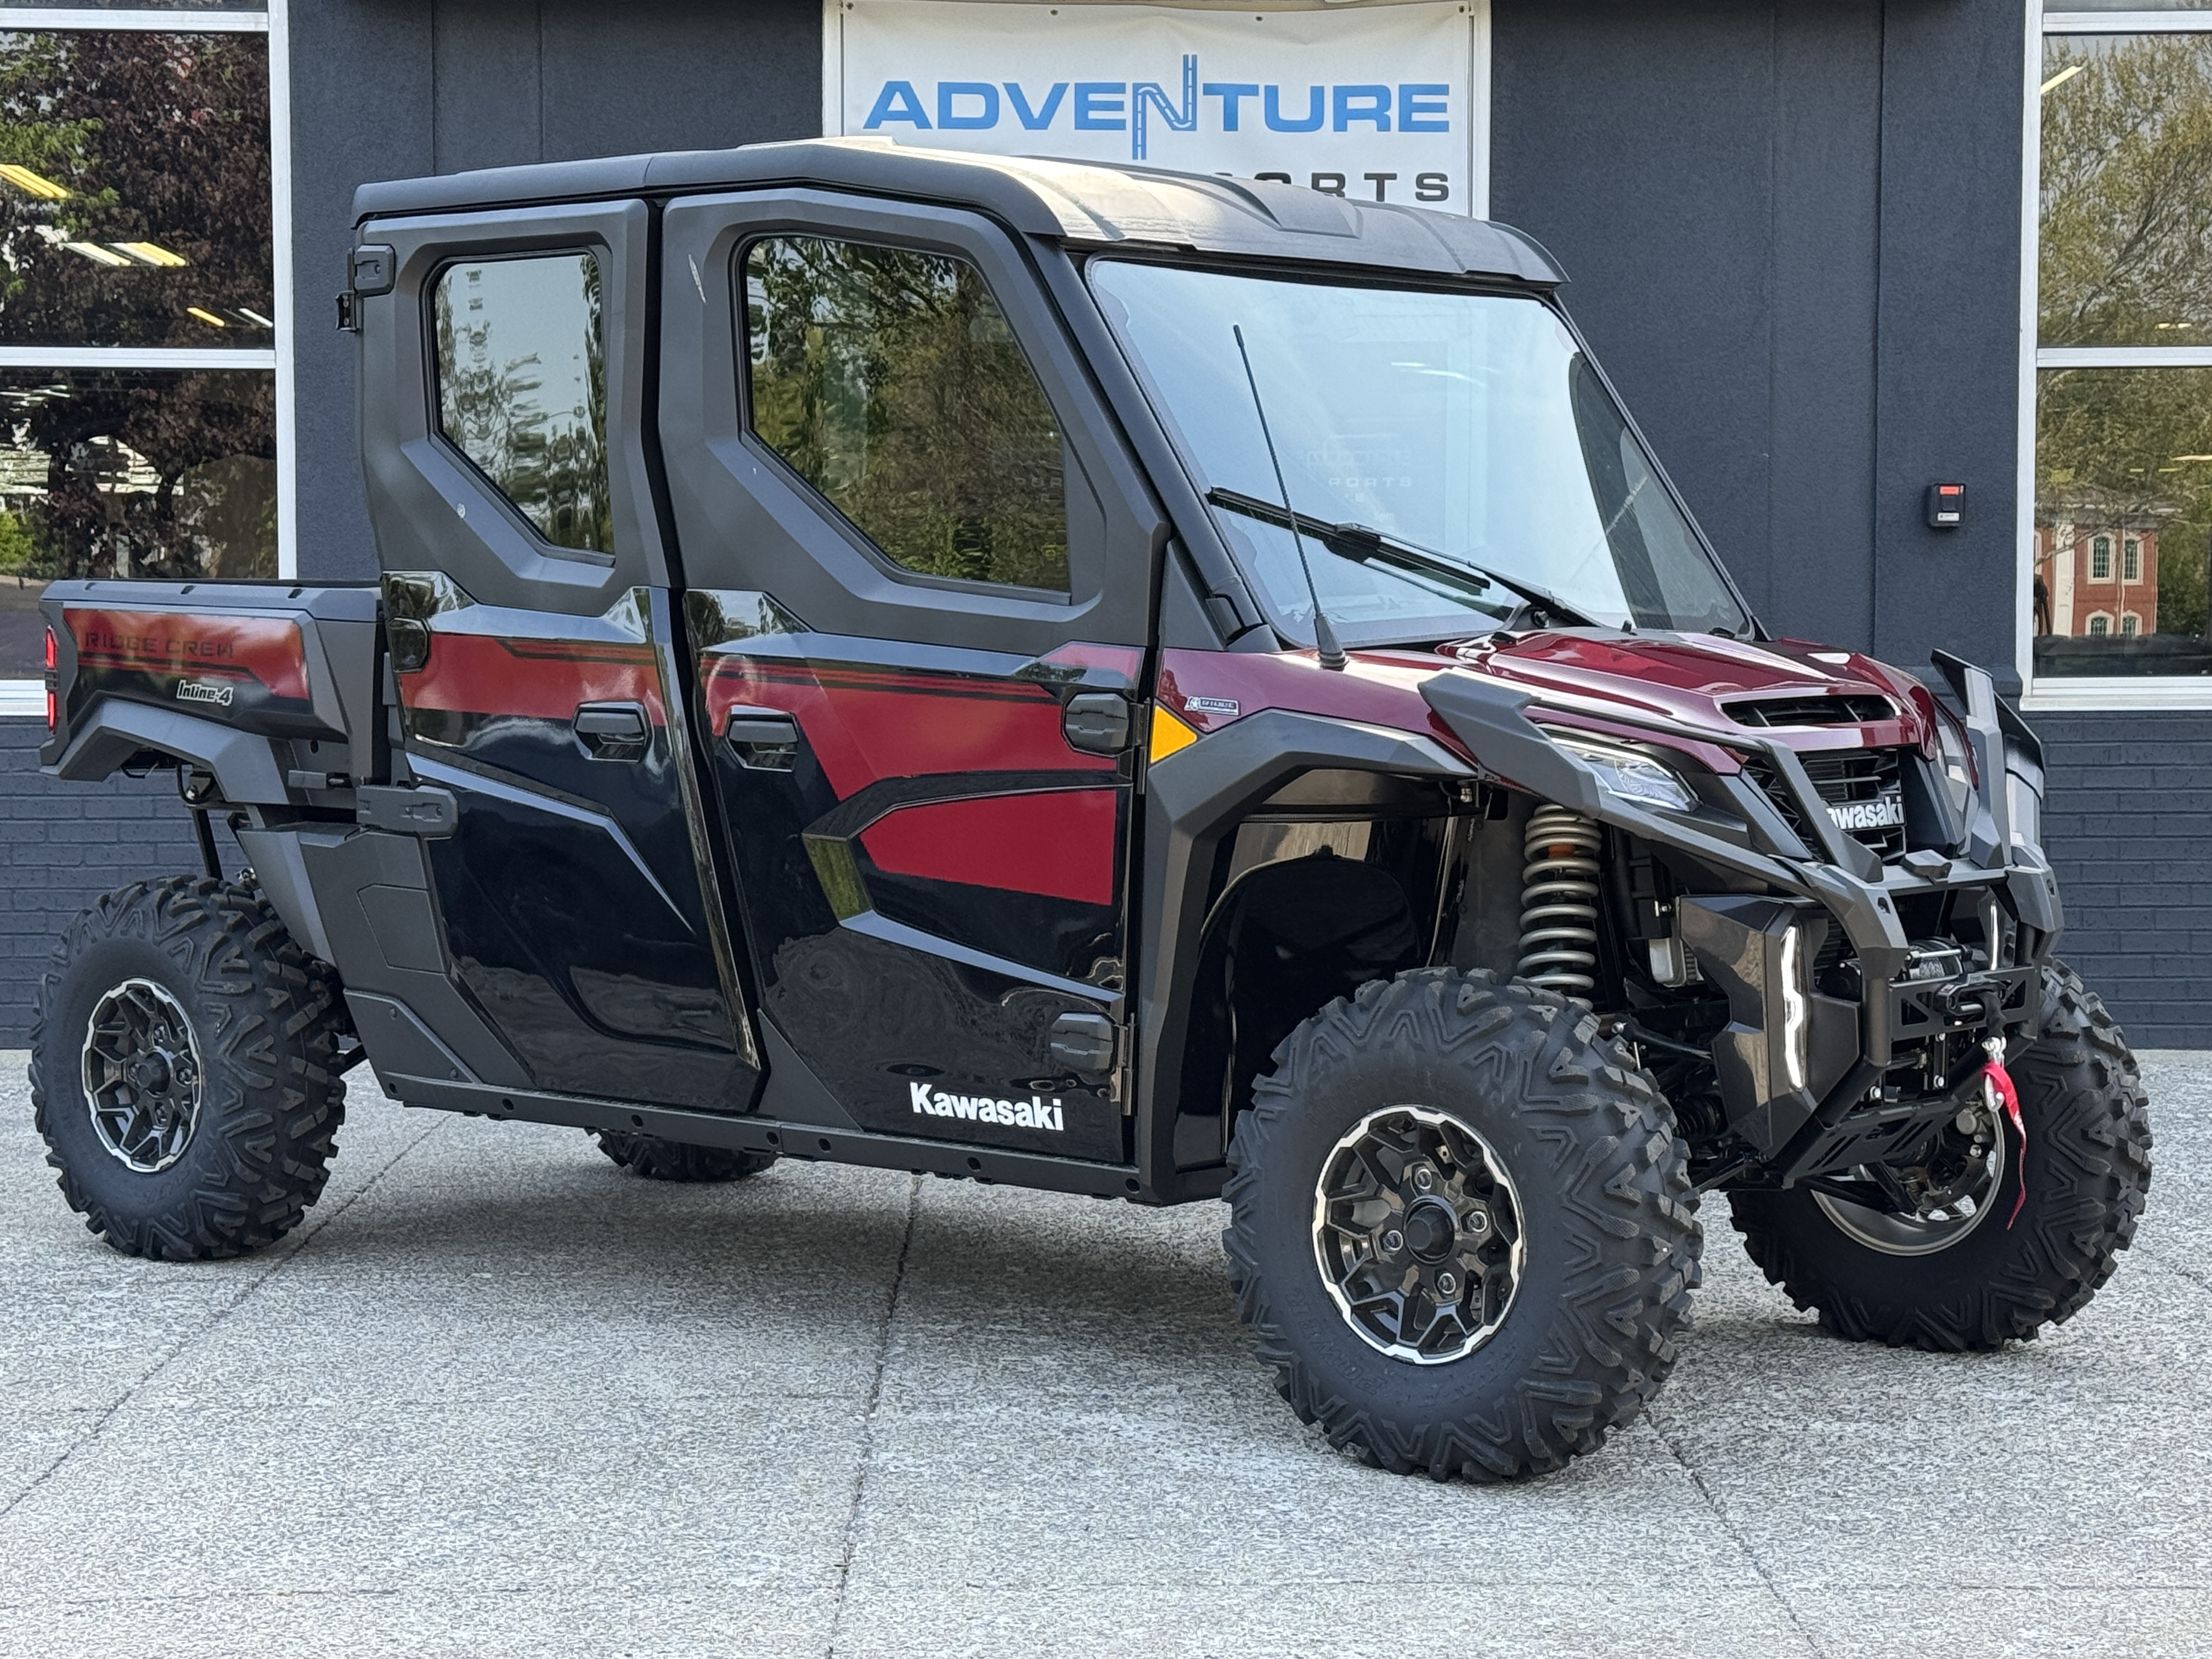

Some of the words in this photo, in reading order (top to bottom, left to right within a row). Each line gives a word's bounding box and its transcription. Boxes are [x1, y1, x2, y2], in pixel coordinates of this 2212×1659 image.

[862, 54, 1450, 160] ADVENTURE
[85, 631, 157, 653] RIDGE
[165, 639, 233, 659] CREW
[176, 679, 234, 707] Inline-4
[910, 1081, 1064, 1131] Kawasaki
